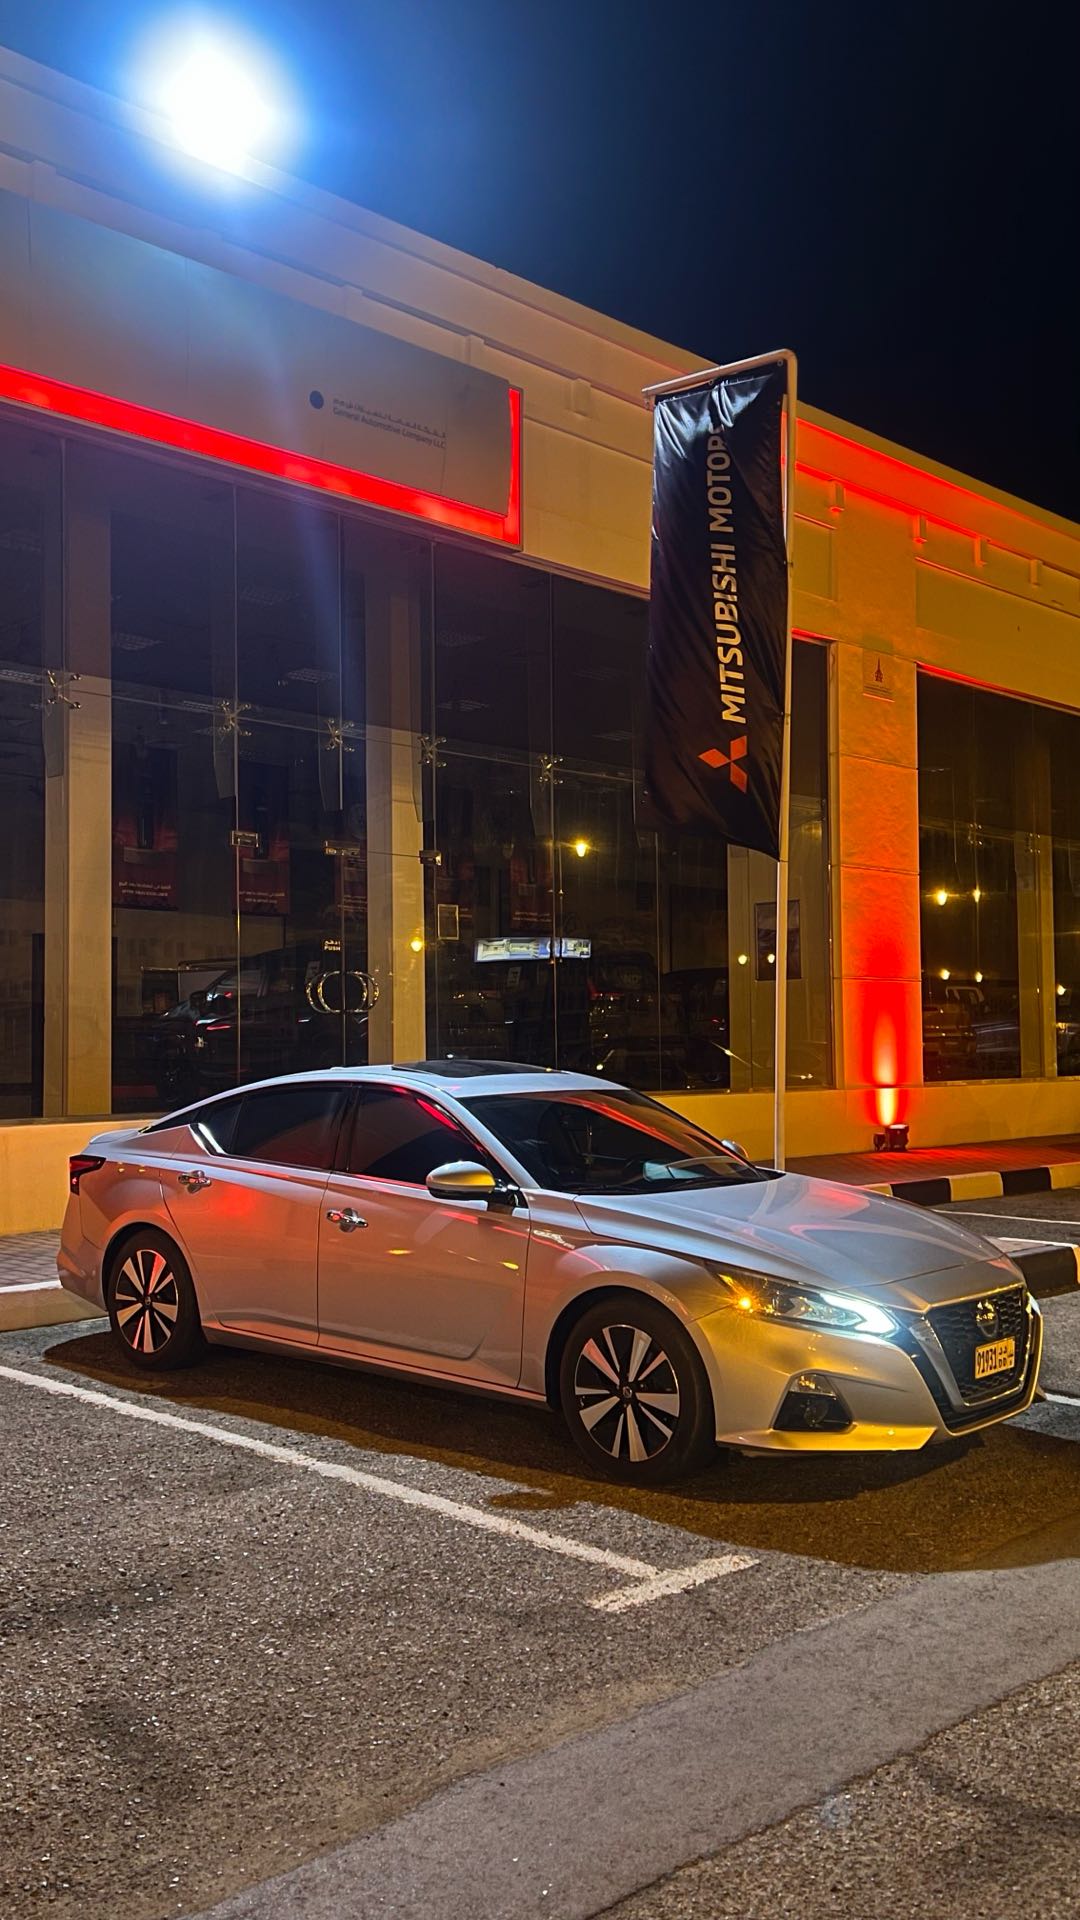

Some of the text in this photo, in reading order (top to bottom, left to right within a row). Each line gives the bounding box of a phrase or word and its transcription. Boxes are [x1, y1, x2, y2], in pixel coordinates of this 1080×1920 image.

[332, 407, 360, 421] General
[361, 415, 401, 434] Automotive
[402, 427, 432, 446] Company
[432, 438, 447, 449] LLC
[710, 543, 747, 724] MITSUBISHI
